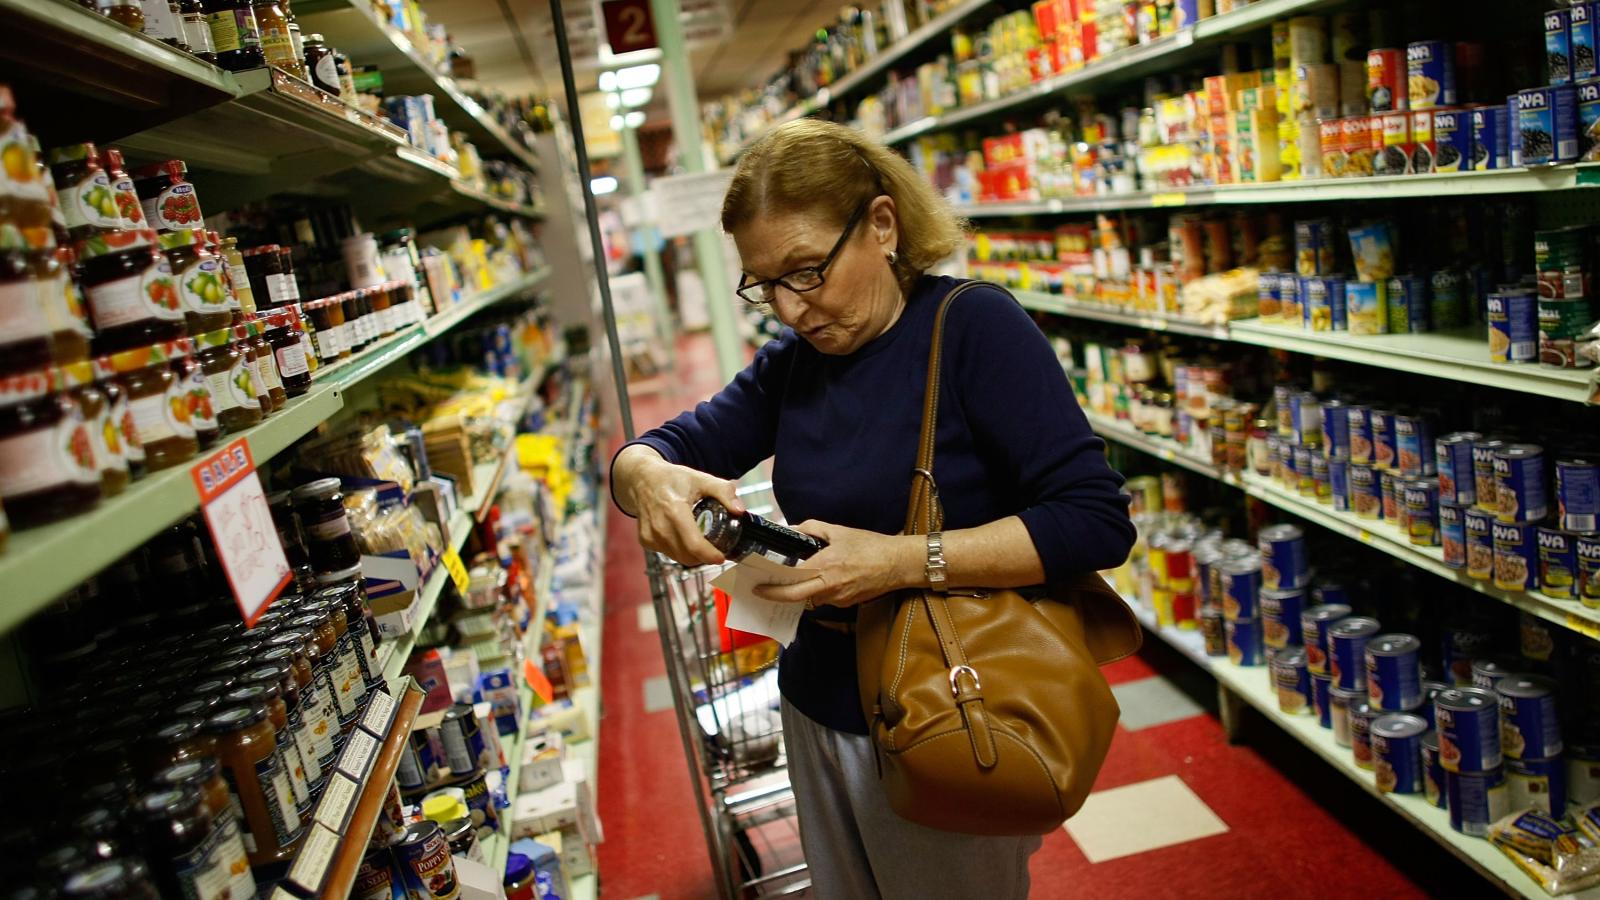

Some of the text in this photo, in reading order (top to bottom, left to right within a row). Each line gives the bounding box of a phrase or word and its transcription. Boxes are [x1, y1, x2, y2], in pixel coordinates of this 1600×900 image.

[618, 8, 649, 43] 2
[200, 444, 248, 493] SALE
[417, 849, 442, 873] POPPY
